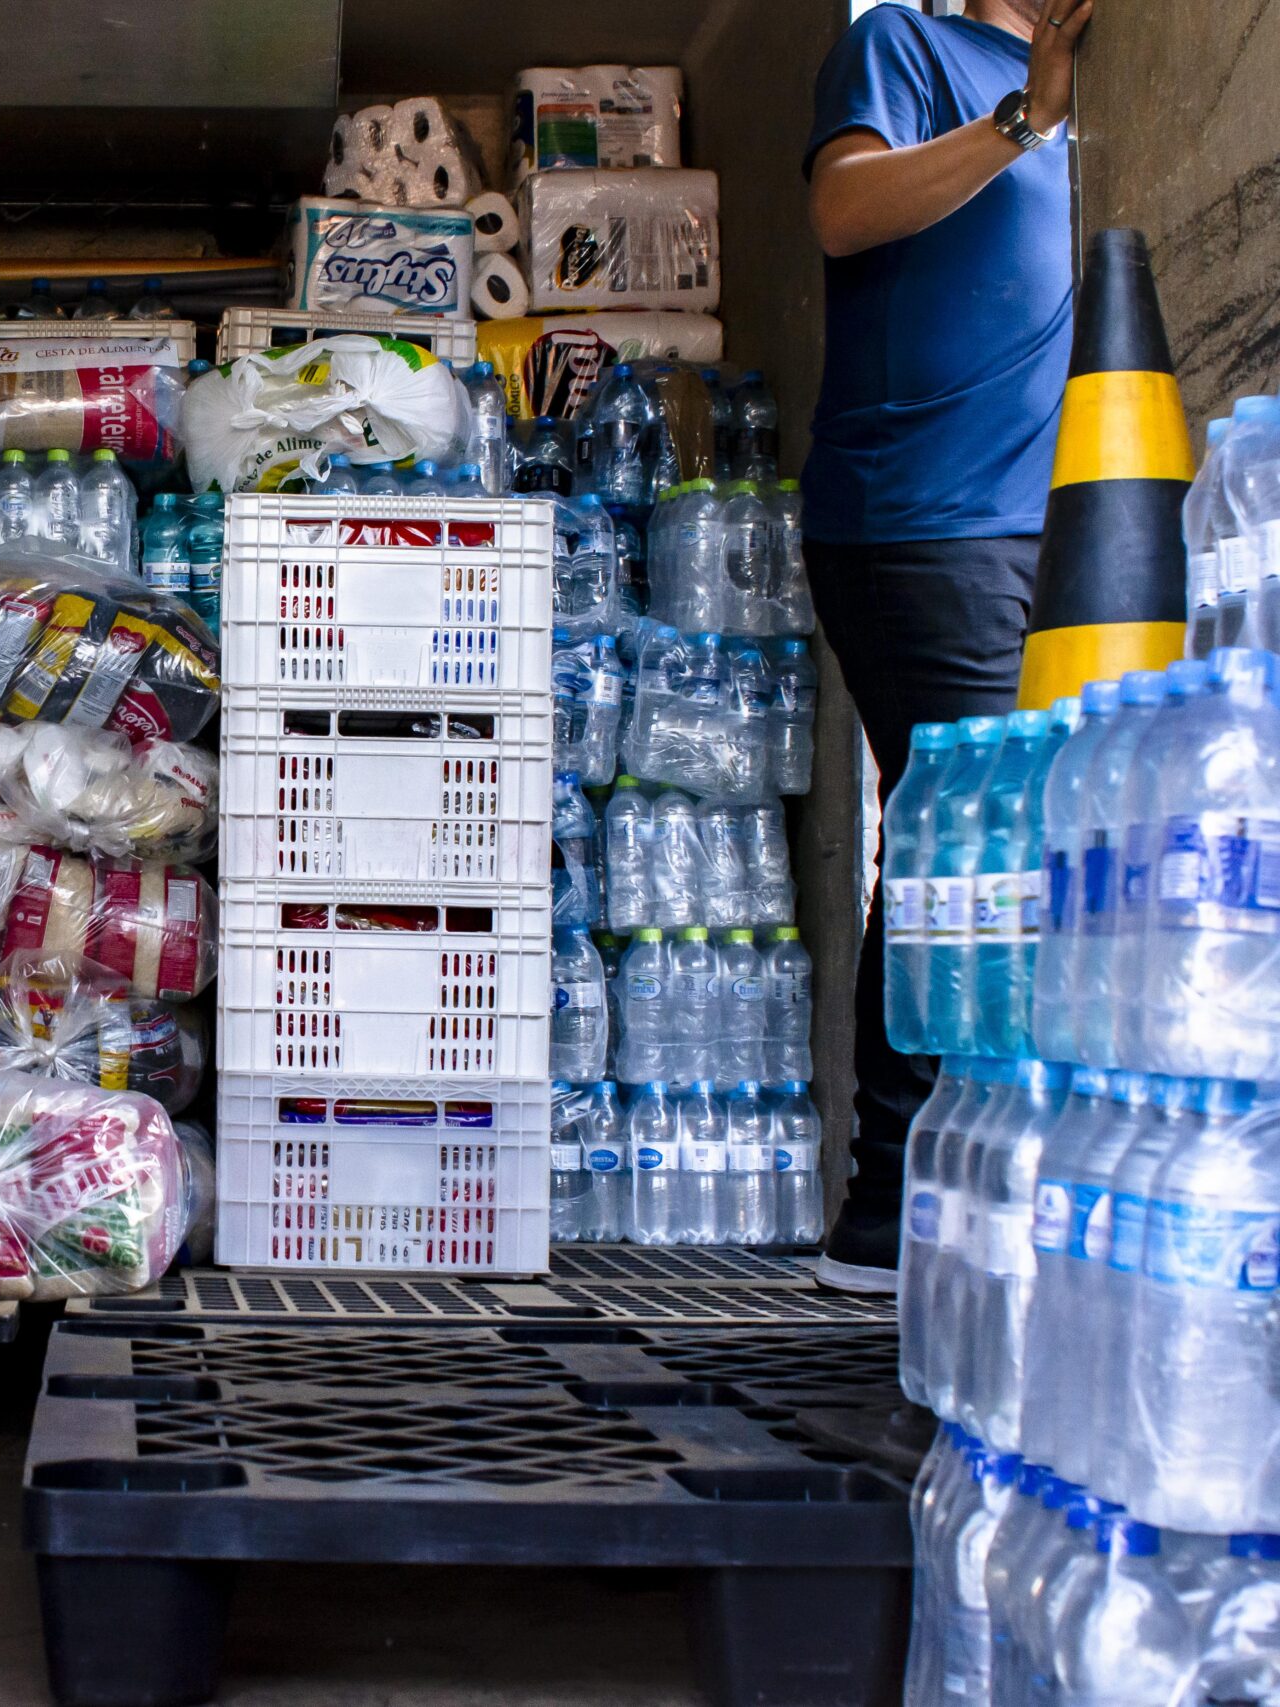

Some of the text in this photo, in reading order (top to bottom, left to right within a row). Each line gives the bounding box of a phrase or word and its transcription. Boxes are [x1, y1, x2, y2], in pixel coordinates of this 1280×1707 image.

[323, 254, 457, 302] Stylus
[36, 343, 171, 359] CESTA DE ALIMENTOS
[236, 436, 326, 493] esta de Alime
[117, 702, 167, 742] Reser
